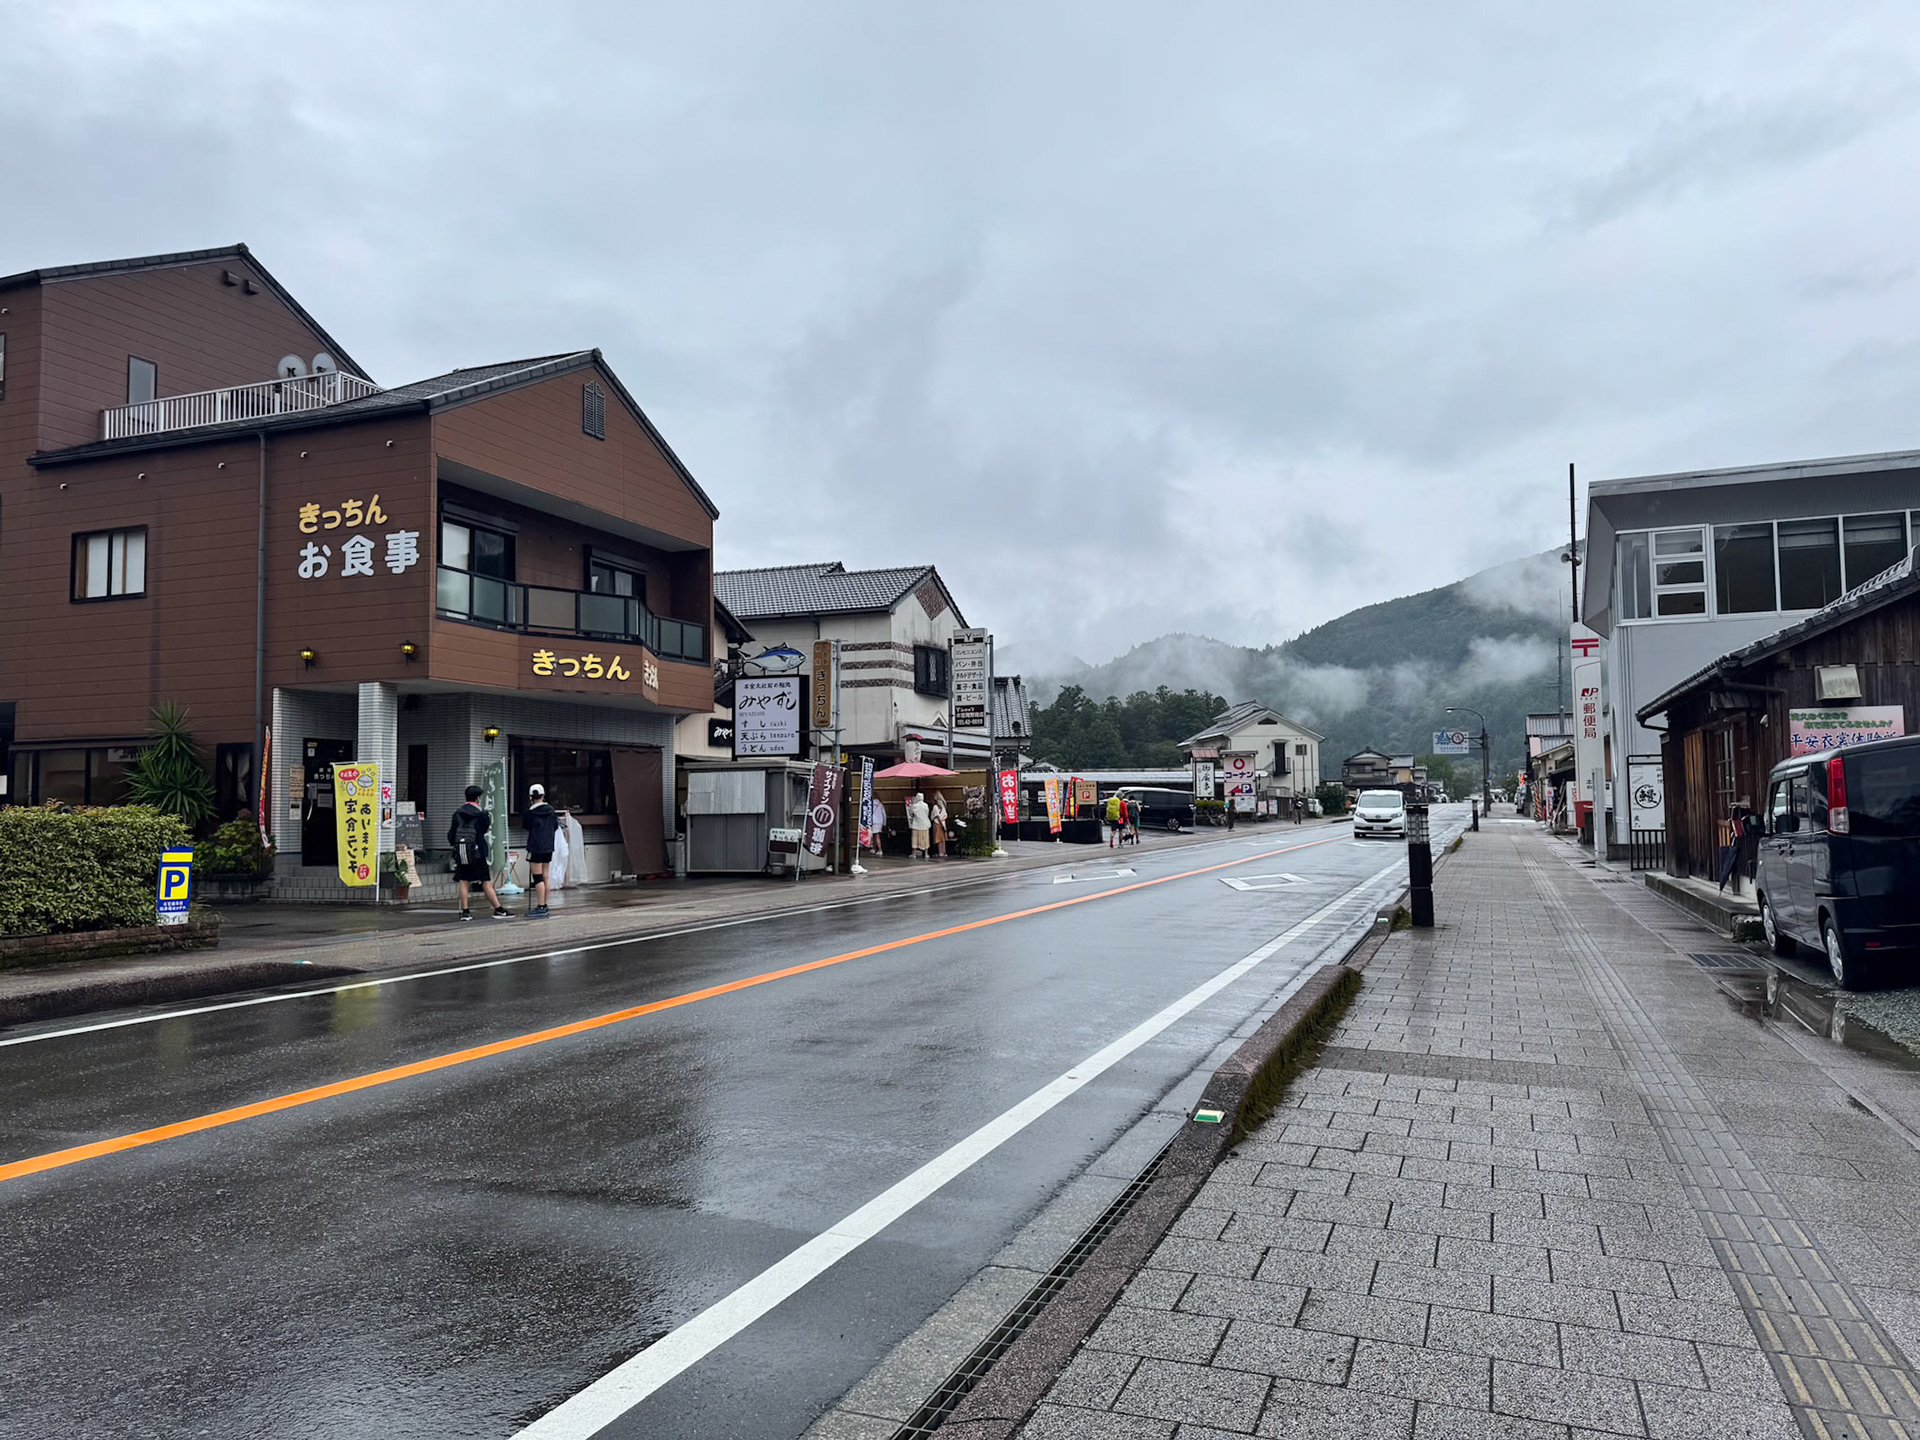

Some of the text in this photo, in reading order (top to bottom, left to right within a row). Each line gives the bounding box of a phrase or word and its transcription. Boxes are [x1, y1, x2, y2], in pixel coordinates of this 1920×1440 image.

[299, 494, 388, 533] きっちん
[298, 530, 420, 578] お食事
[532, 649, 630, 680] きっちん
[816, 670, 827, 717] きっちん
[714, 726, 733, 739] みや
[1583, 703, 1596, 739] 郵便局
[742, 744, 766, 752] うどん
[1225, 771, 1254, 779] コーナン
[1242, 785, 1250, 793] P
[164, 870, 186, 898] P
